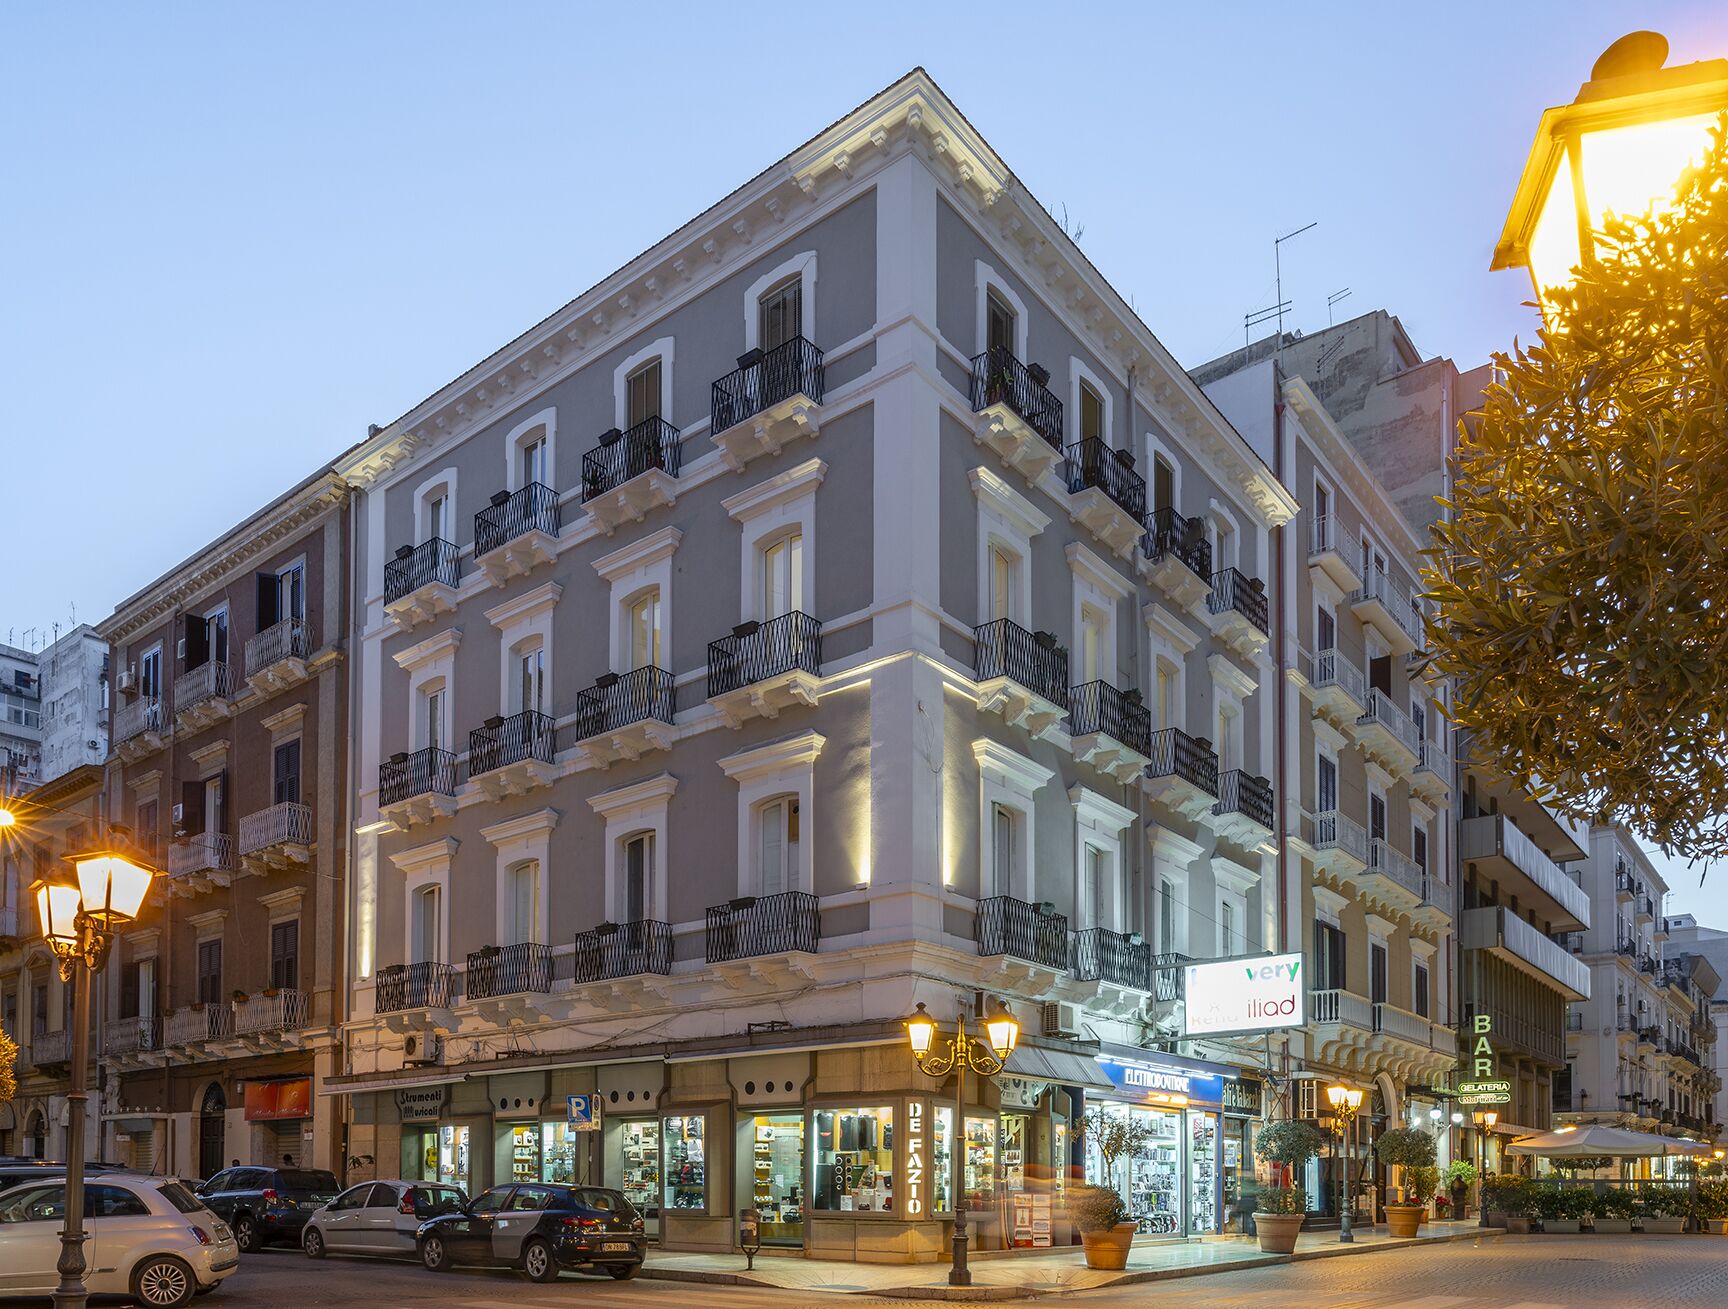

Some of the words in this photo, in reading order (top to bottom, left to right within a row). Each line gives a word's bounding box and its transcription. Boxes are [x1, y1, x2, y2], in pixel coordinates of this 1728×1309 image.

[1245, 961, 1300, 982] very
[1247, 994, 1296, 1019] iliad
[1473, 1014, 1493, 1077] BAR
[400, 1089, 442, 1105] Strumenti
[1460, 1083, 1508, 1092] GELATERIA
[571, 1097, 586, 1118] P
[908, 1102, 923, 1133] DE
[906, 1138, 923, 1214] FAZIO
